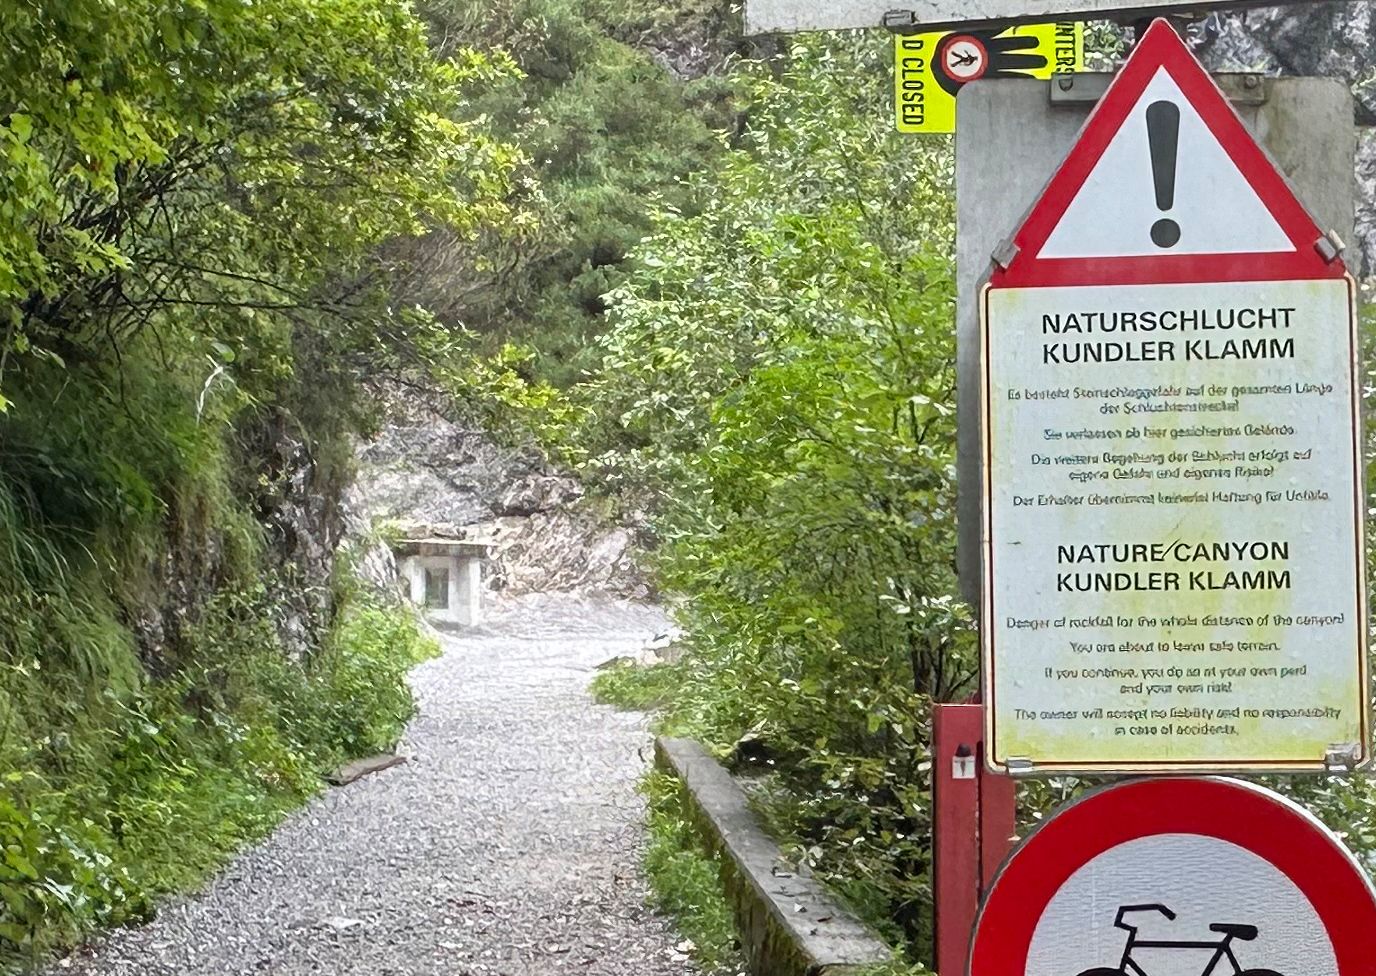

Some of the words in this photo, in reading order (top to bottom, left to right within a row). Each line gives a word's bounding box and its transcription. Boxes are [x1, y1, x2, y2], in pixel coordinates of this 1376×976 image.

[902, 58, 924, 125] CLOSED
[1042, 308, 1296, 334] NATURSCHLUCHT
[1043, 341, 1175, 364] KUNDLER
[1185, 338, 1295, 362] KLAMM
[1208, 384, 1229, 396] der
[1100, 403, 1121, 414] der
[1144, 426, 1167, 438] hier
[1167, 451, 1189, 463] der
[1013, 496, 1035, 506] Der
[1057, 572, 1181, 592] KUNDLER
[1189, 570, 1291, 591] KLAMM
[1006, 617, 1050, 631] Danger
[1117, 616, 1134, 627] for
[1137, 616, 1158, 627] the
[1160, 615, 1198, 627] whole
[1256, 614, 1270, 627] of
[1273, 615, 1293, 626] the
[1069, 641, 1093, 654] You
[1096, 644, 1116, 652] are
[1119, 641, 1154, 653] about
[1157, 642, 1170, 652] to
[1056, 670, 1079, 680] you
[1141, 668, 1164, 680] you
[1167, 666, 1184, 680] do
[1219, 668, 1247, 679] your
[1249, 667, 1278, 677] own
[1120, 682, 1144, 694] and
[1146, 685, 1173, 696] your
[1177, 684, 1204, 694] own
[1014, 709, 1037, 720] The
[1082, 708, 1104, 719] will
[1151, 710, 1168, 719] no
[1216, 707, 1241, 718] and
[1243, 709, 1260, 718] no
[1129, 726, 1158, 735] case
[1160, 724, 1174, 735] of
